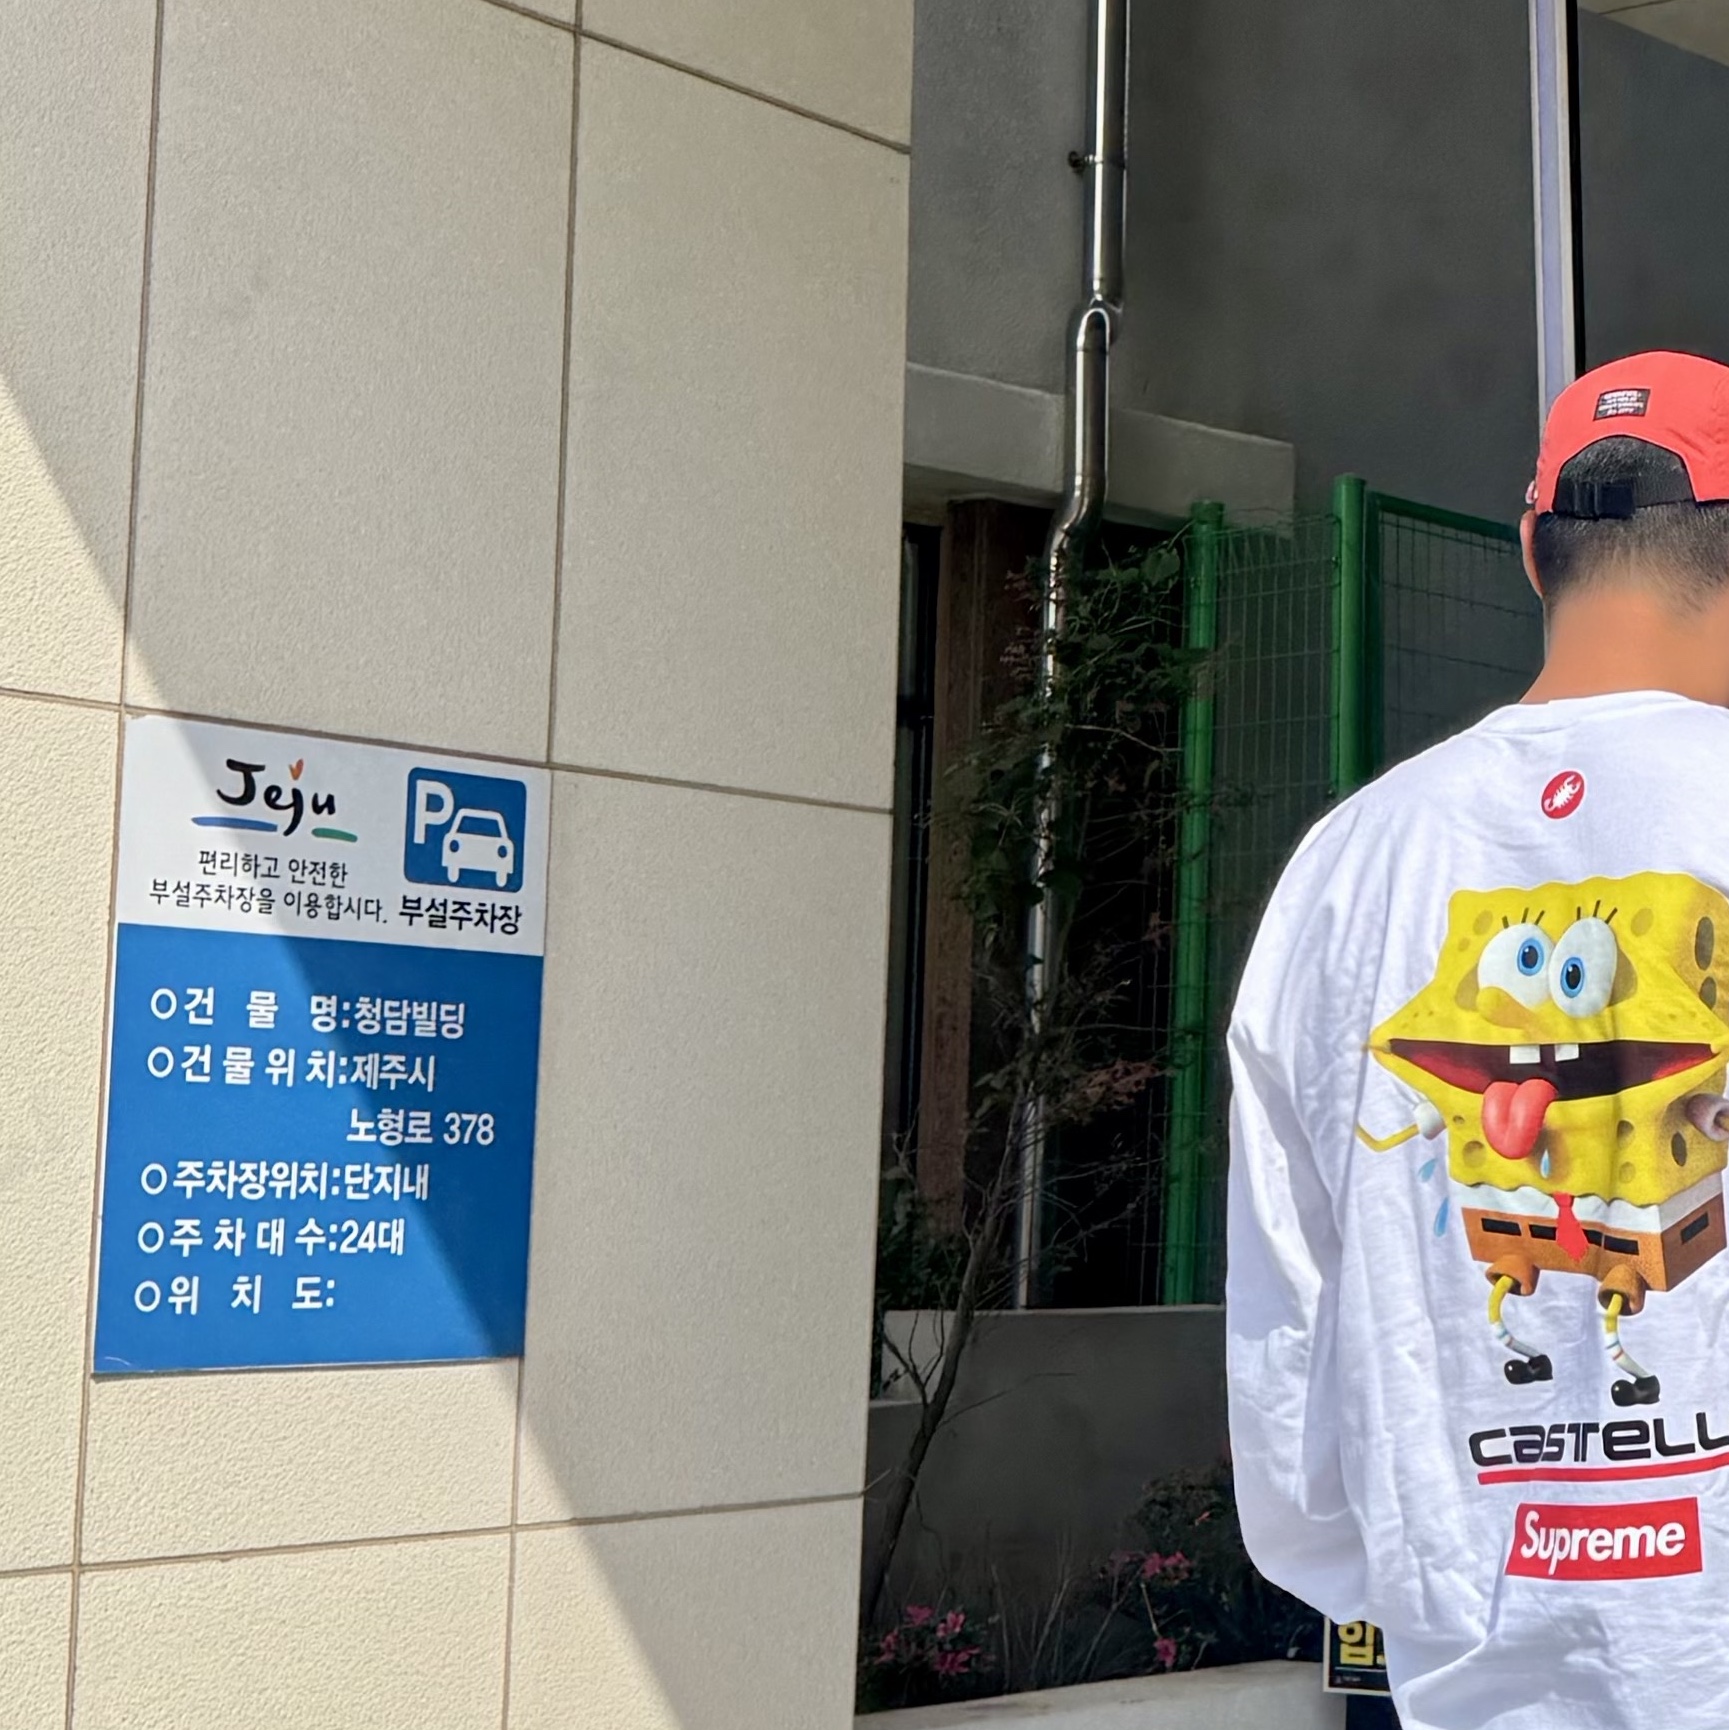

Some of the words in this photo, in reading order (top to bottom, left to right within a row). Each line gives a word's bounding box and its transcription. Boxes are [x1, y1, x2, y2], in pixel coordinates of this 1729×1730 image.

[215, 758, 337, 837] Jeju
[198, 849, 281, 880] 편리하고
[287, 856, 348, 889] 안전한
[149, 878, 276, 913] 부설주차장을
[283, 890, 388, 925] 이용합시다.
[398, 894, 522, 935] 부설주차장
[346, 1108, 433, 1145] 노형로
[443, 1112, 495, 1146] 378
[1520, 1510, 1686, 1576] Supreme
